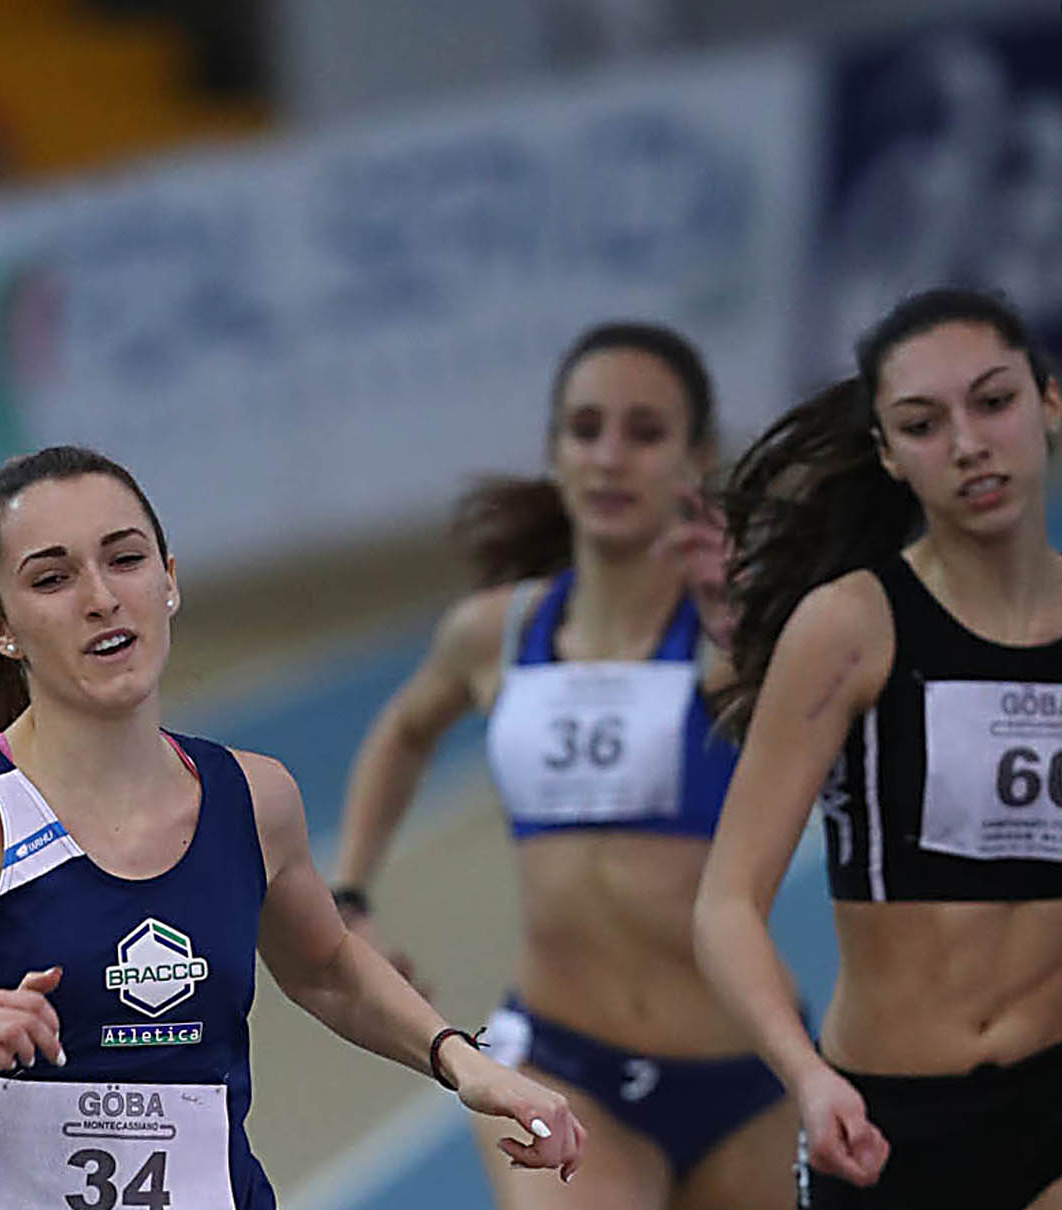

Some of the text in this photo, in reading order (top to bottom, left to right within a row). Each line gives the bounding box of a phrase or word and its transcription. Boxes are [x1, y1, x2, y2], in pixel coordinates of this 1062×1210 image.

[1000, 687, 1062, 717] GÖB
[545, 716, 624, 770] 36
[109, 962, 205, 987] BRACCO
[105, 1027, 200, 1044] Atletica
[78, 1085, 165, 1117] GÖBA
[83, 1121, 158, 1131] MONTECASSIANO
